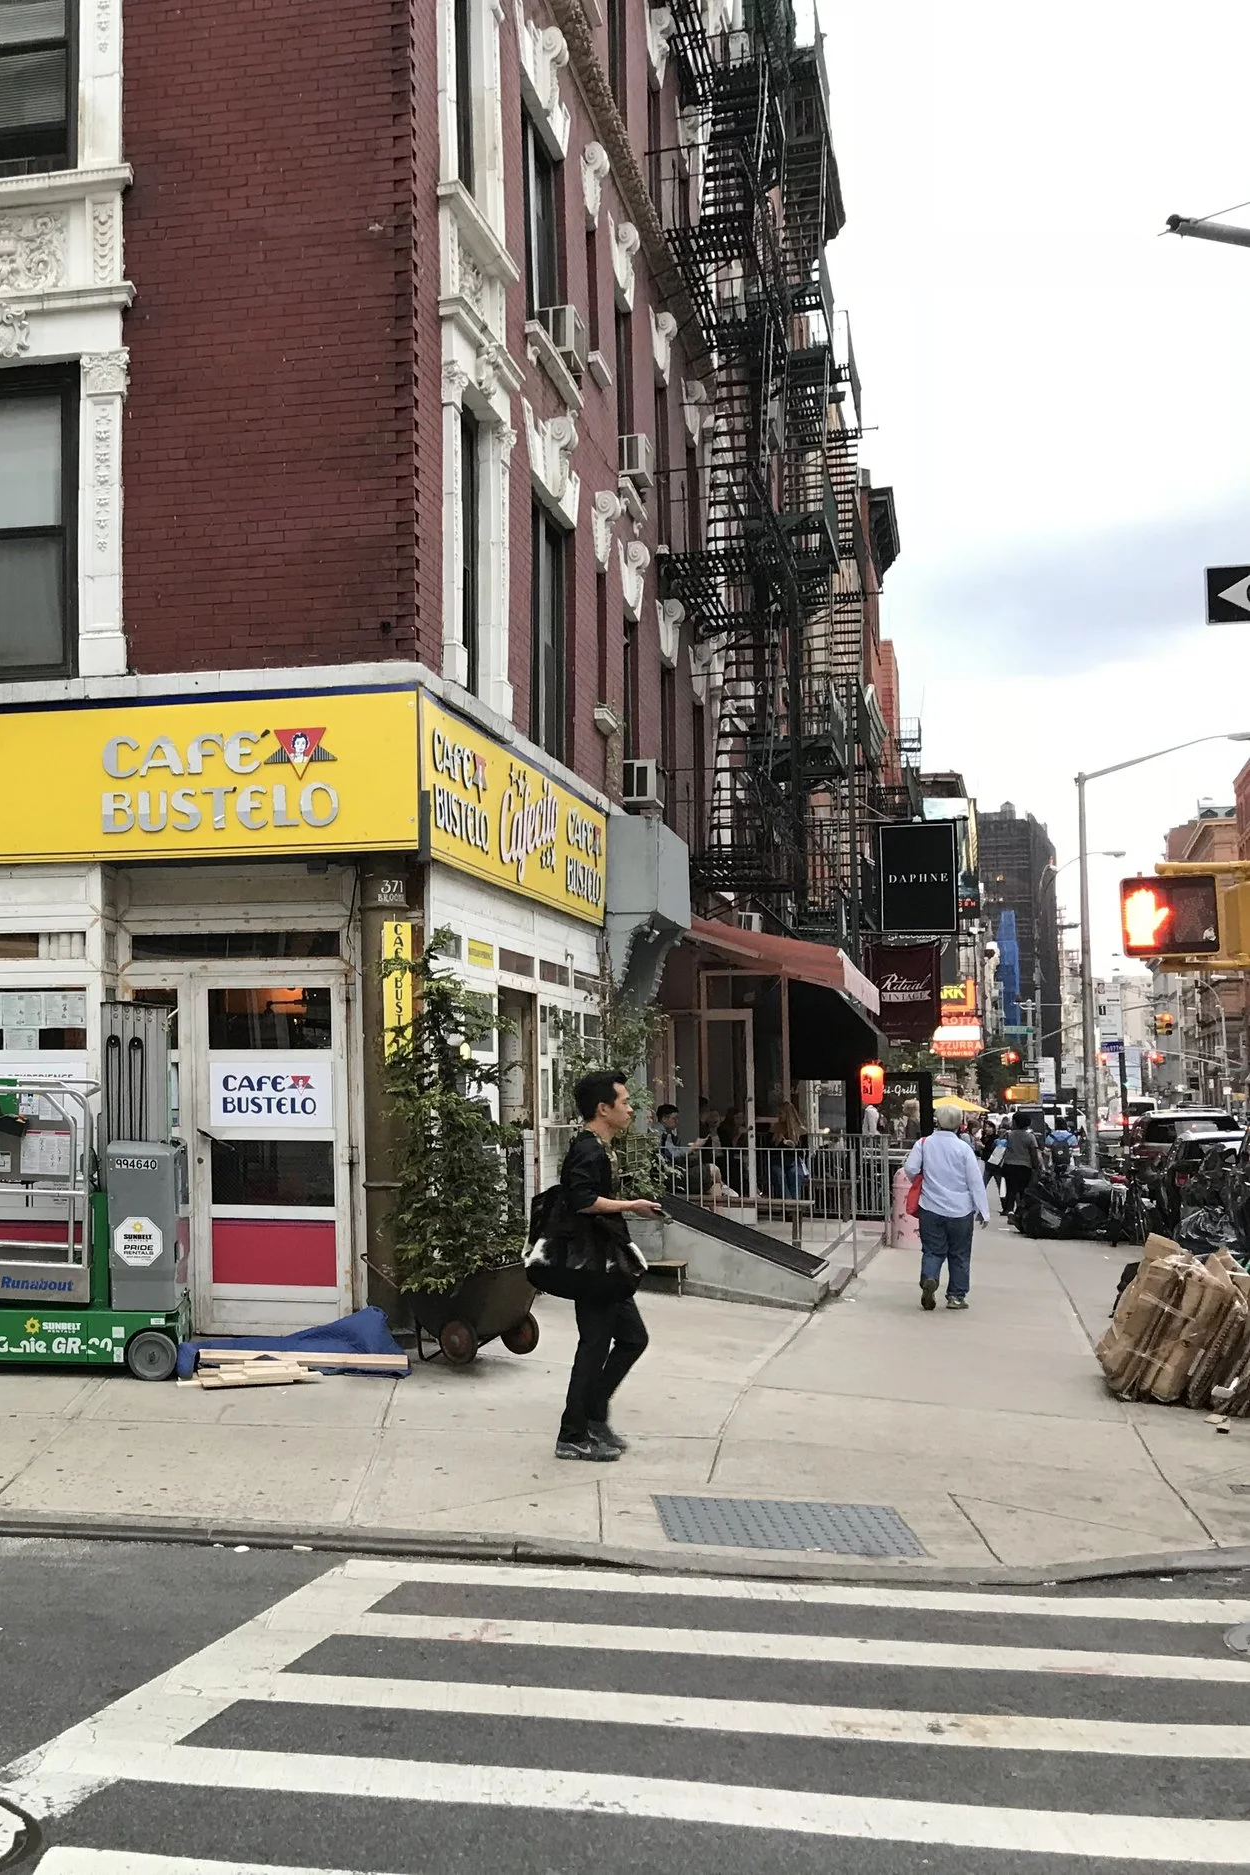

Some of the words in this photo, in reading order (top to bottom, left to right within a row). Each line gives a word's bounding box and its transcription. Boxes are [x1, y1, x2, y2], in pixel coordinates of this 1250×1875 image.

[102, 782, 339, 834] BUSTELO
[433, 783, 489, 855] BUSTELO
[499, 777, 558, 884] Cafecito
[889, 873, 949, 884] DAPHNE
[381, 879, 404, 894] 371
[881, 973, 931, 991] Ritual
[881, 991, 924, 1001] VINTAGE
[941, 1016, 982, 1026] ROTTA
[933, 1040, 984, 1050] AZZURRA
[222, 1096, 317, 1115] BUSTELO
[115, 1158, 157, 1170] 994640
[1, 1276, 74, 1292] Runabout
[42, 1322, 81, 1331] SUNBELT
